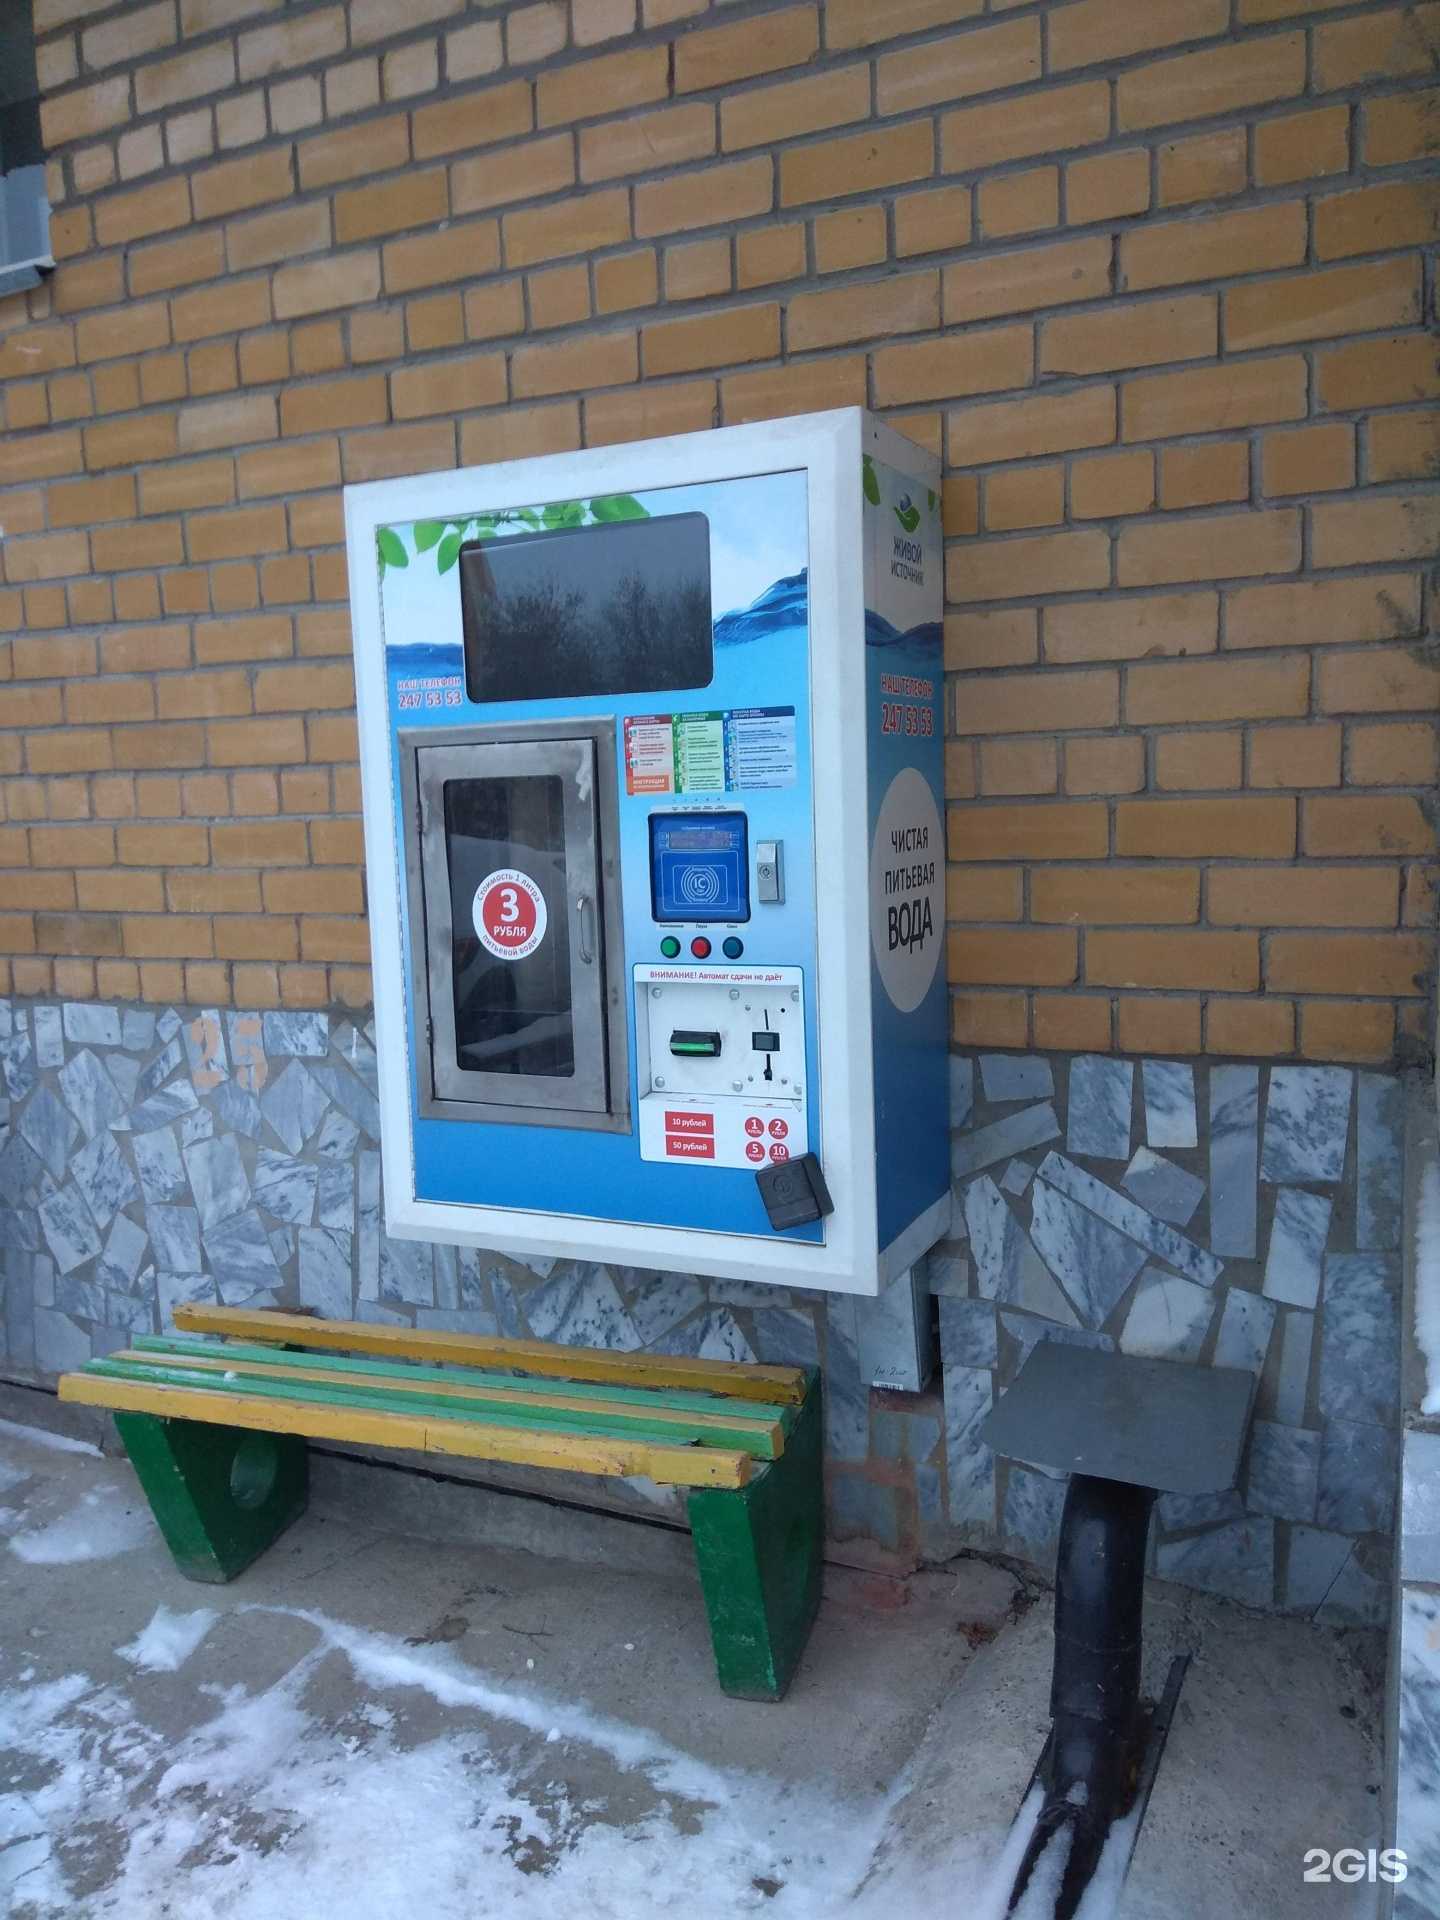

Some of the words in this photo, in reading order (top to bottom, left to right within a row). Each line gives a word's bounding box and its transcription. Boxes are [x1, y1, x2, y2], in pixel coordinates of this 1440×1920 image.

[893, 535, 922, 566] ЖИВОЙ
[890, 559, 925, 587] ИСТОЧНИК
[881, 673, 901, 694] НАШ
[901, 676, 934, 699] ТЕЛЕФОН
[399, 693, 422, 708] 247
[426, 691, 442, 706] 53
[446, 689, 461, 705] 53
[882, 703, 903, 735] 247
[905, 706, 919, 736] 53
[920, 708, 934, 737] 53
[891, 827, 928, 854] ЧИСТАЯ
[477, 873, 514, 901] Стоимость
[514, 874, 521, 882] 1
[521, 879, 541, 903] литра
[694, 878, 707, 889] IC
[885, 862, 935, 895] ПИТЬЕВАЯ
[500, 888, 520, 922] 3
[493, 925, 527, 937] РУБЛЯ
[888, 896, 933, 954] ВОДА
[482, 934, 518, 956] питьевой
[519, 936, 539, 954] воды
[650, 970, 697, 979] ВНИМАНИЕ!
[699, 972, 729, 981] Автомат
[672, 1118, 681, 1126] 10
[682, 1119, 707, 1128] рублей
[751, 1119, 758, 1130] 1
[774, 1120, 782, 1131] 2
[682, 1142, 708, 1152] рублей
[752, 1143, 759, 1154] 5
[772, 1145, 786, 1156] 10
